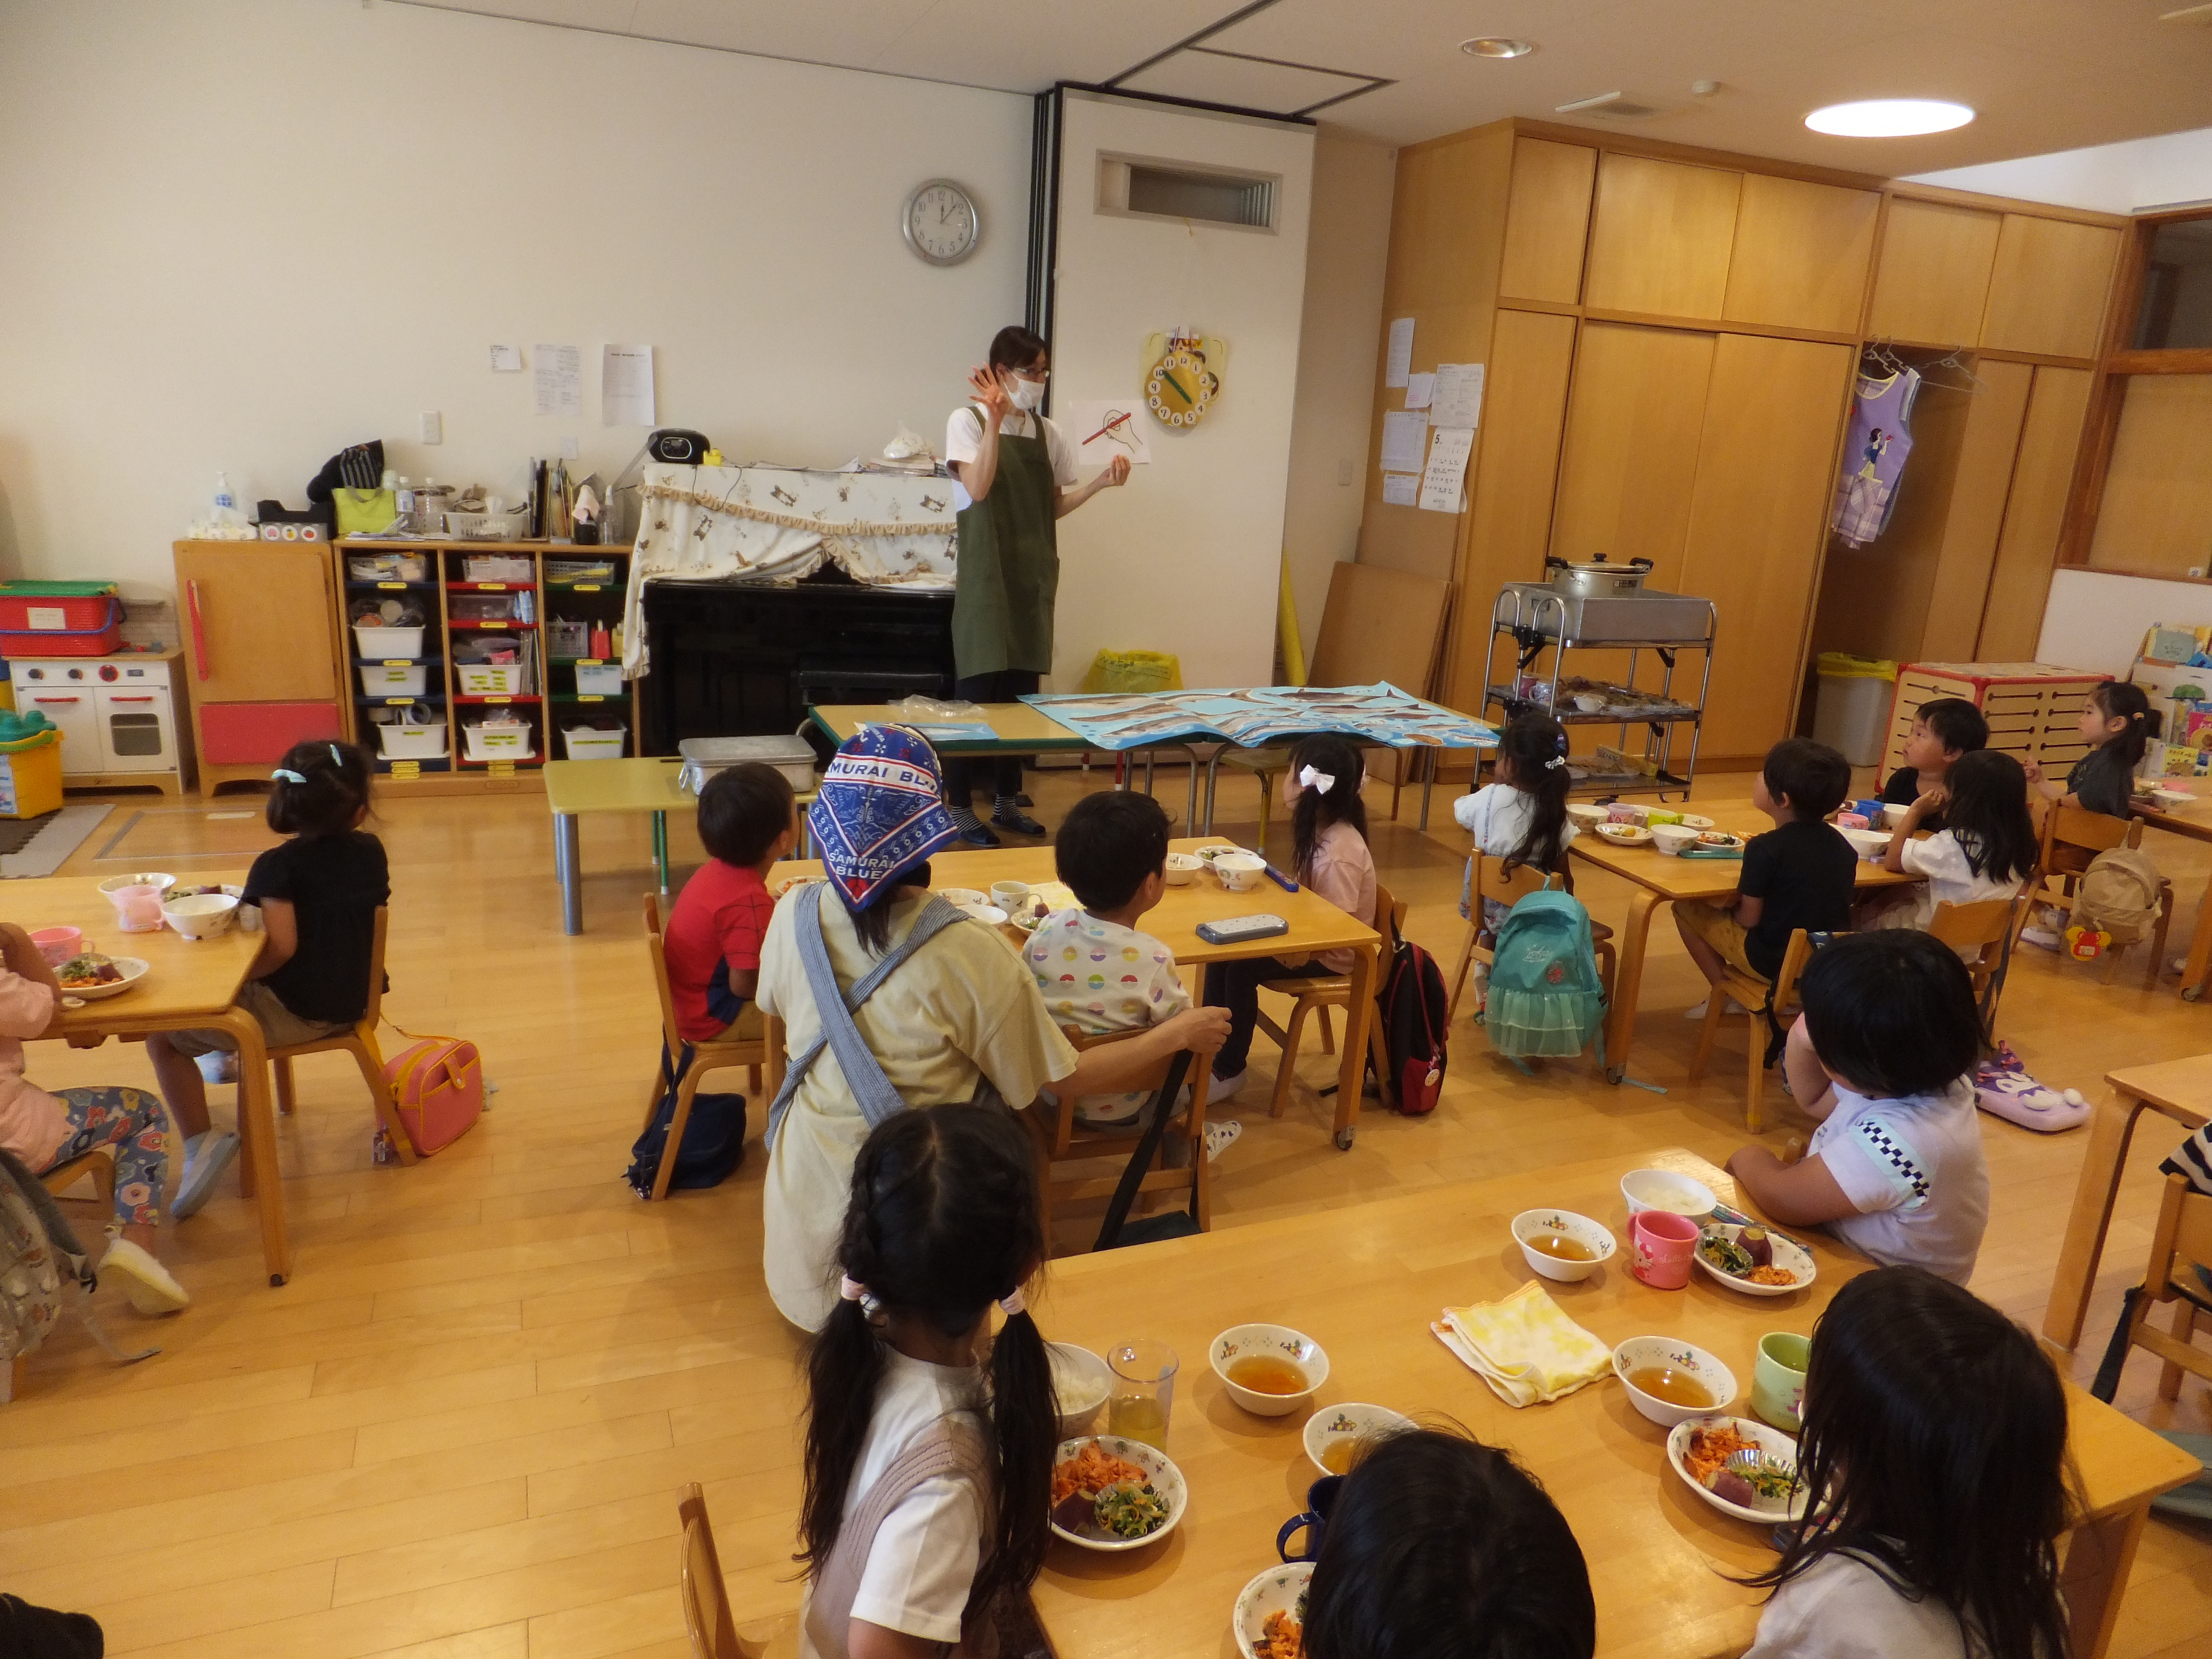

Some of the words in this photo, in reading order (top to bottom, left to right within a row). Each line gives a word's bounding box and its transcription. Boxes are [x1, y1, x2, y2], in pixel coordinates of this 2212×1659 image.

[928, 193, 934, 203] 11
[938, 191, 945, 200] 12
[919, 203, 925, 212] 10
[958, 204, 963, 214] 2
[915, 216, 920, 226] 9
[962, 218, 967, 228] 3
[919, 230, 925, 240] 8
[958, 233, 962, 241] 4
[929, 240, 933, 251] 7
[939, 244, 944, 254] 6
[950, 241, 955, 252] 5
[1152, 383, 1156, 391] 9
[1435, 434, 1440, 444] 5
[830, 853, 895, 868] SAMURAI
[836, 866, 883, 879] BLUE
